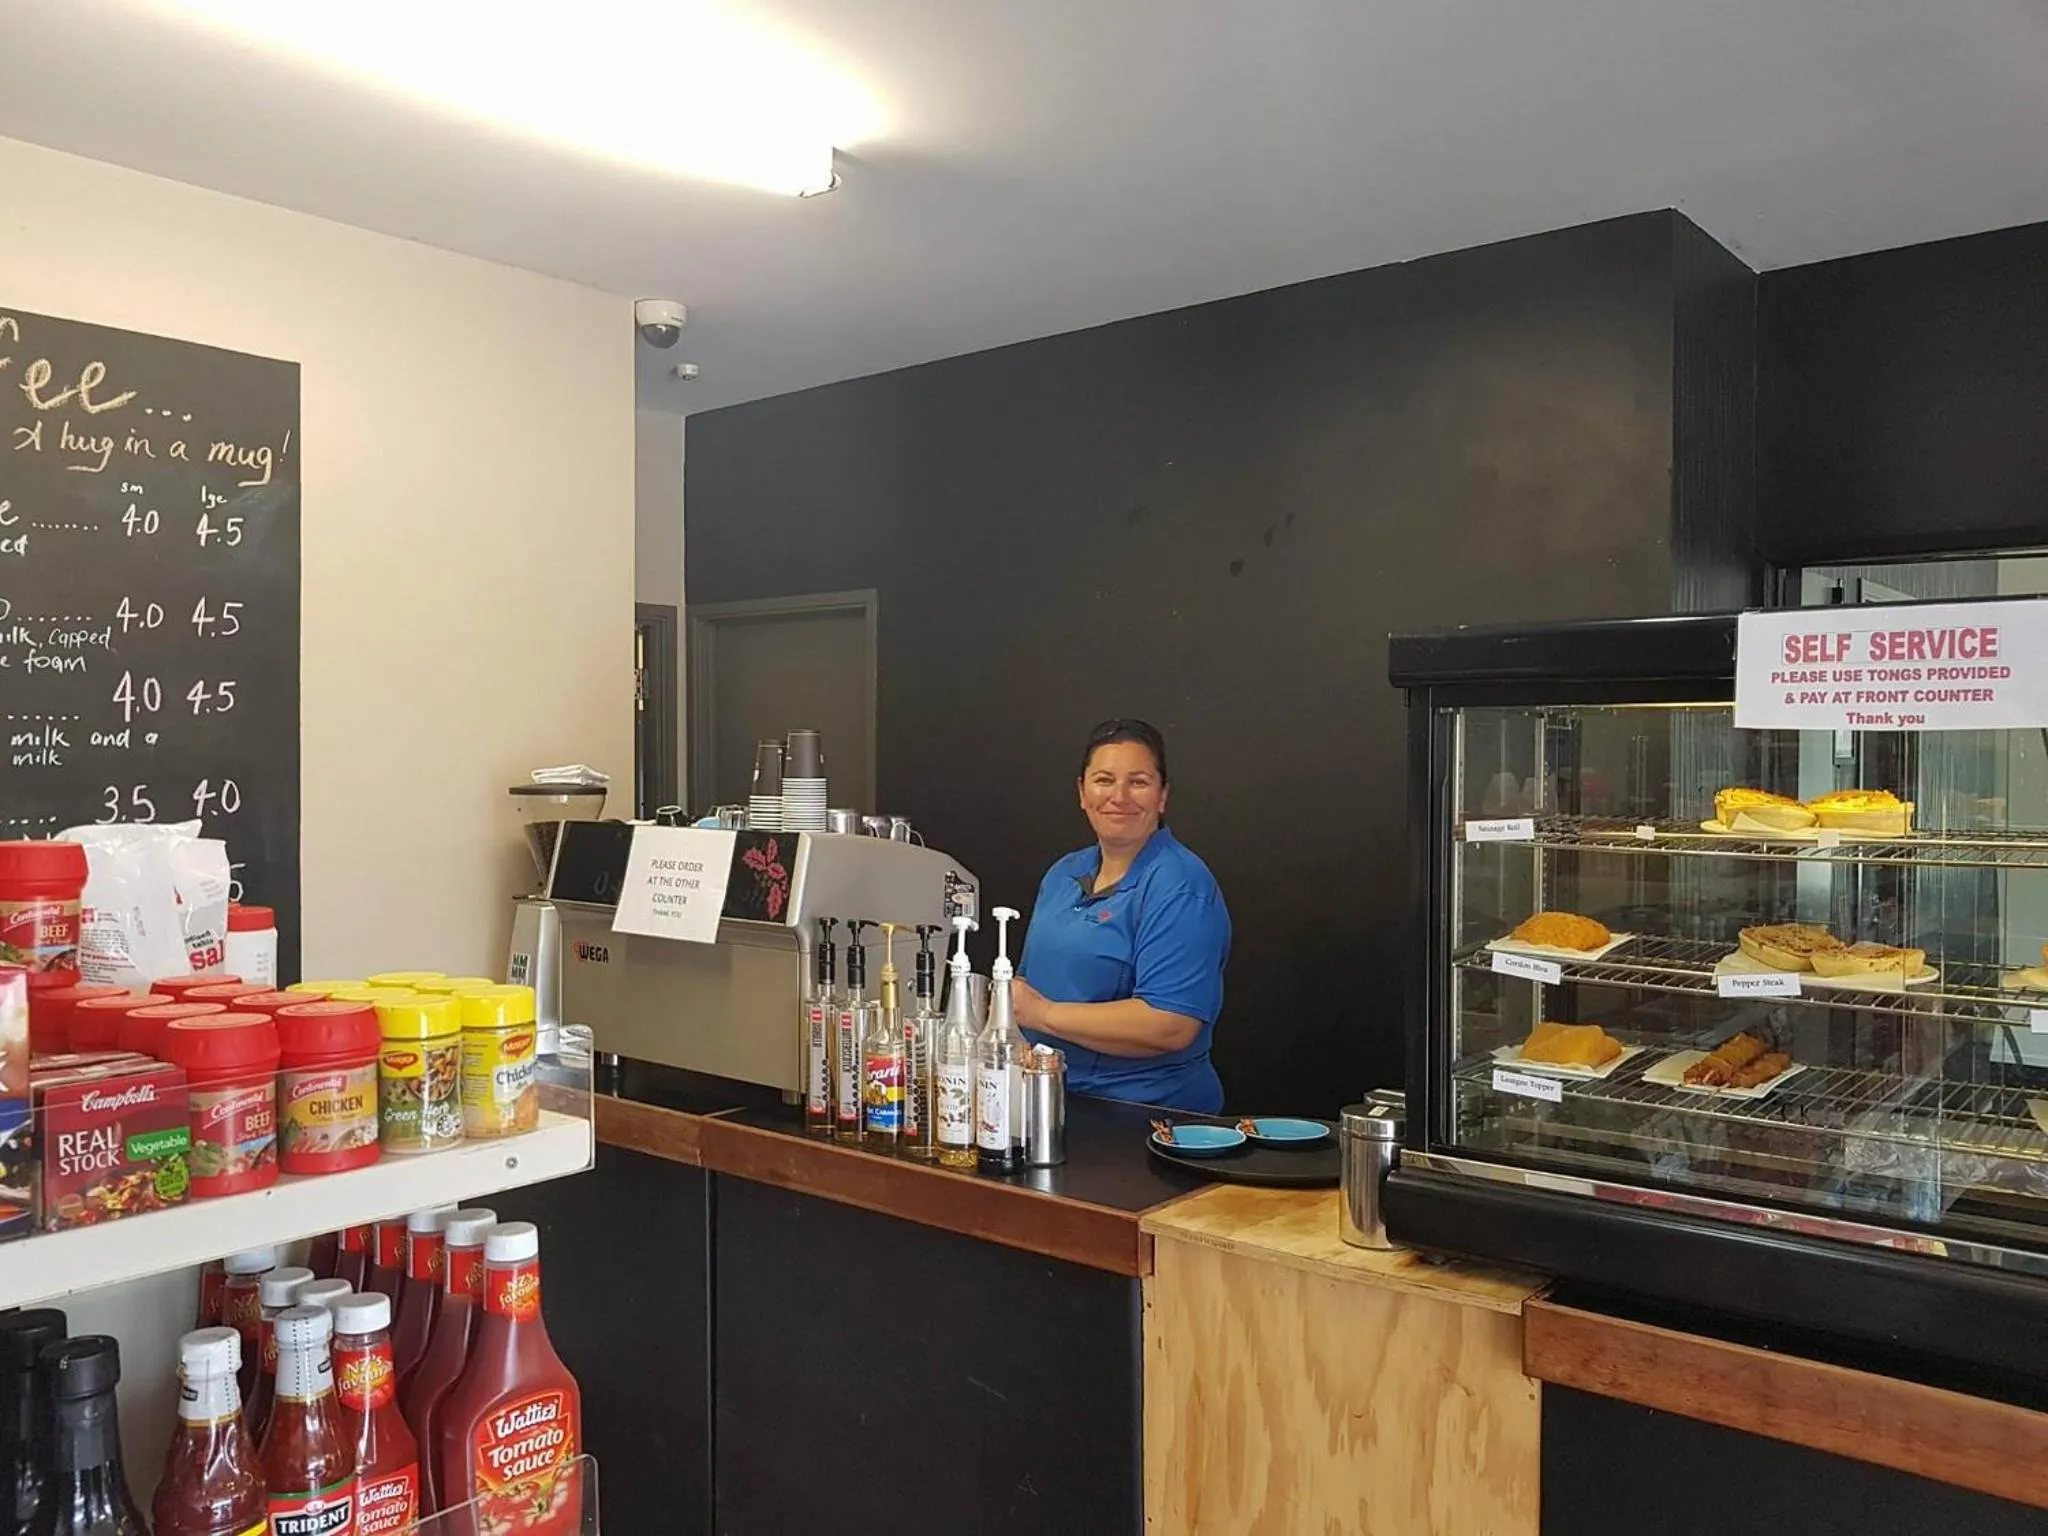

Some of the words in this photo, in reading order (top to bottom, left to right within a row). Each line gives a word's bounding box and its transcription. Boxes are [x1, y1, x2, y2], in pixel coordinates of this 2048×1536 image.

[60, 422, 114, 472] hug
[124, 428, 156, 458] in
[169, 440, 189, 461] a
[208, 430, 291, 486] mug!
[121, 504, 160, 536] 4.0
[196, 513, 243, 546] 4.5
[116, 597, 163, 633] 4.0
[192, 596, 243, 637] 4.5
[1785, 633, 1852, 664] SELF
[1869, 628, 1998, 661] SERVICE
[24, 648, 87, 674] foam
[1771, 670, 1828, 684] PLEASE
[1833, 669, 1863, 683] USE
[1868, 668, 1922, 682] TONGS
[1928, 666, 2011, 680] PROVIDED
[113, 670, 161, 723] 4.0
[187, 680, 236, 715] 4.5
[1785, 692, 1795, 704] &
[1800, 692, 1828, 704] PAY
[1832, 691, 1852, 704] AT
[1856, 690, 1909, 703] FRONT
[1914, 689, 1993, 702] COUNTER
[1846, 712, 1893, 725] Thank
[1898, 714, 1925, 727] you
[11, 725, 70, 748] milk
[90, 729, 129, 748] and
[145, 733, 159, 746] a
[12, 748, 62, 766] milk
[95, 785, 156, 824] 3.5
[193, 779, 241, 816] 4.0
[651, 859, 676, 870] PLEASE
[678, 862, 704, 872] ORDER
[647, 876, 657, 886] AT
[659, 877, 673, 887] THE
[675, 878, 701, 889] OTHER
[652, 893, 687, 905] COUNTER
[41, 924, 69, 939] BEEF
[190, 940, 225, 972] sal
[578, 944, 610, 964] WEGA
[1732, 979, 1760, 989] Pepper
[1763, 978, 1784, 987] Steak
[309, 1095, 363, 1116] CHICKEN
[384, 1105, 417, 1122] Green
[245, 1110, 271, 1131] BEEF
[59, 1127, 120, 1157] REAL
[131, 1134, 187, 1155] Vegetable
[59, 1148, 120, 1176] STOCK
[488, 1429, 564, 1468] Tomato
[503, 1449, 555, 1482] sauce
[278, 1508, 351, 1535] TRIDENT
[360, 1517, 405, 1535] sauce
